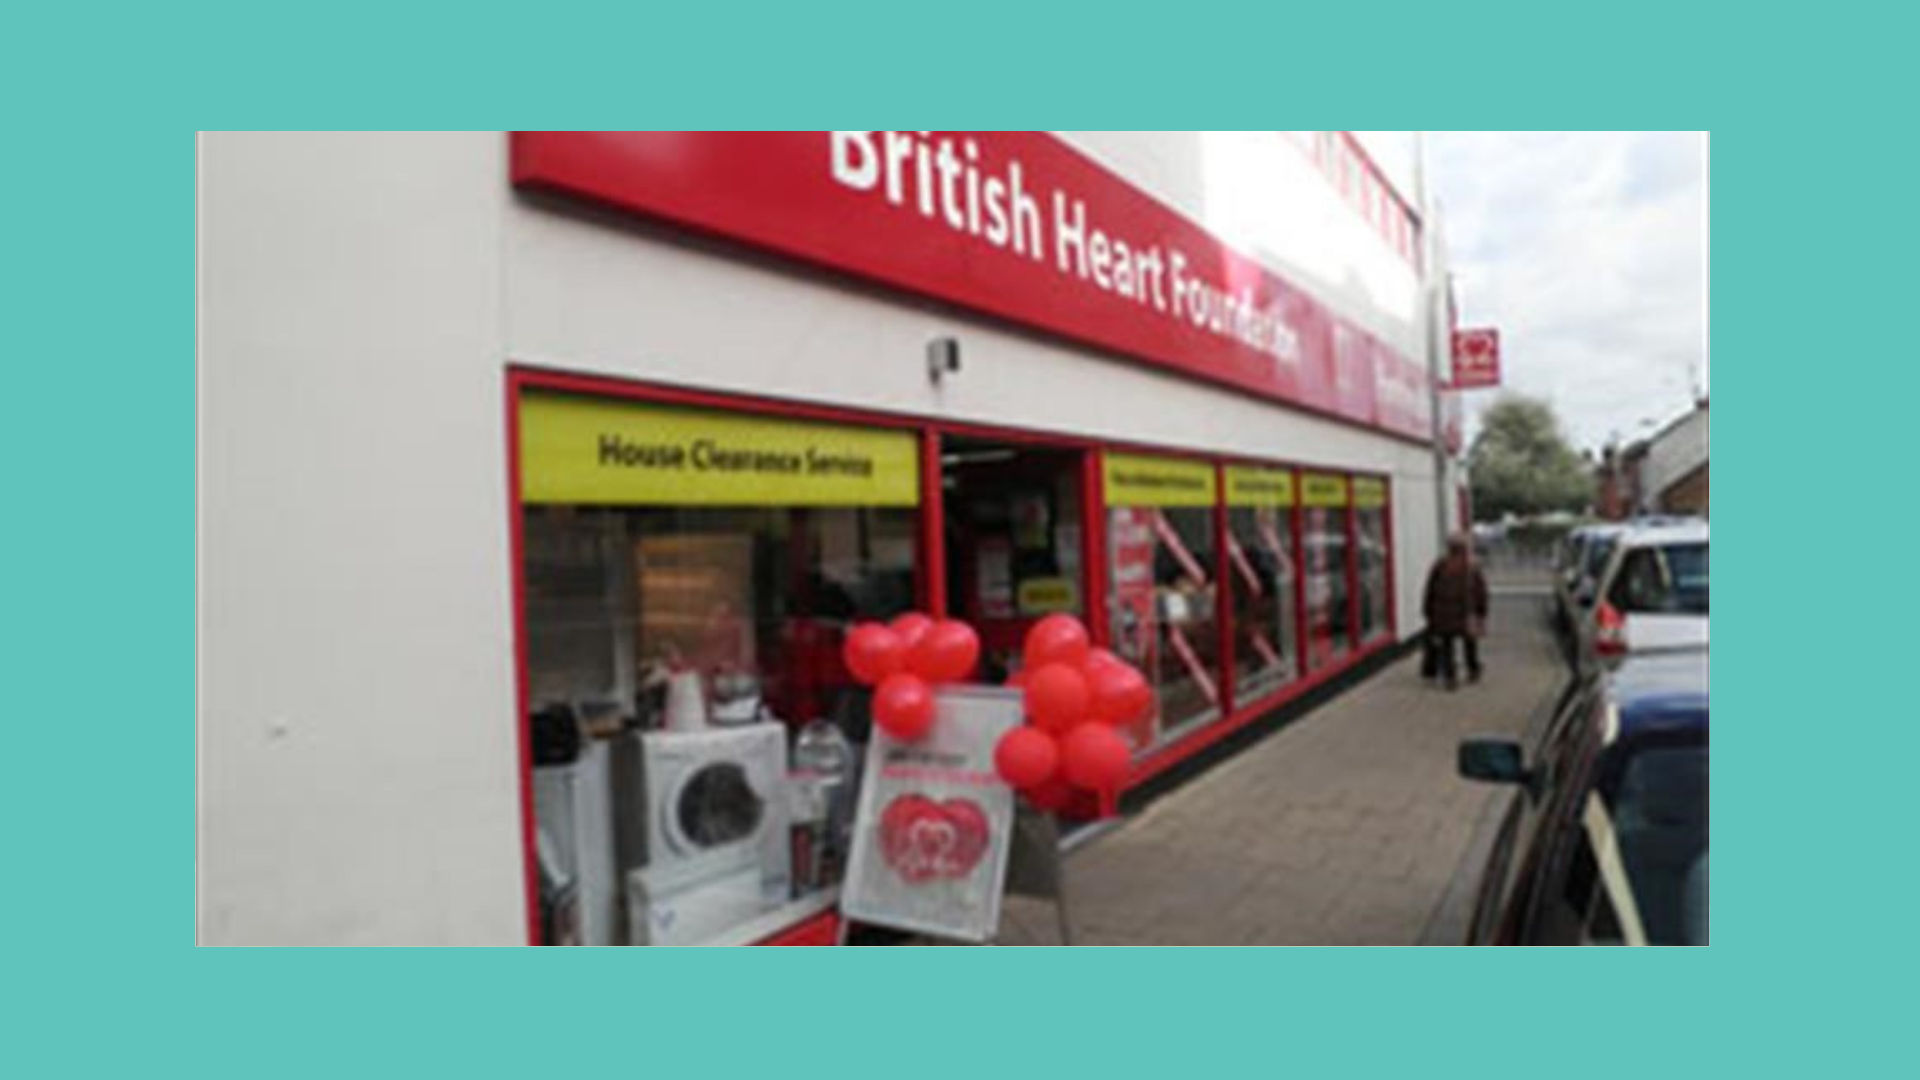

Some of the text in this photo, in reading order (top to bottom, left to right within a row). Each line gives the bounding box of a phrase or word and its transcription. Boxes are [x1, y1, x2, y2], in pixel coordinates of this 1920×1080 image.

[829, 131, 1043, 261] British
[1053, 189, 1166, 311] Heart
[598, 433, 874, 478] House Clearance Service
